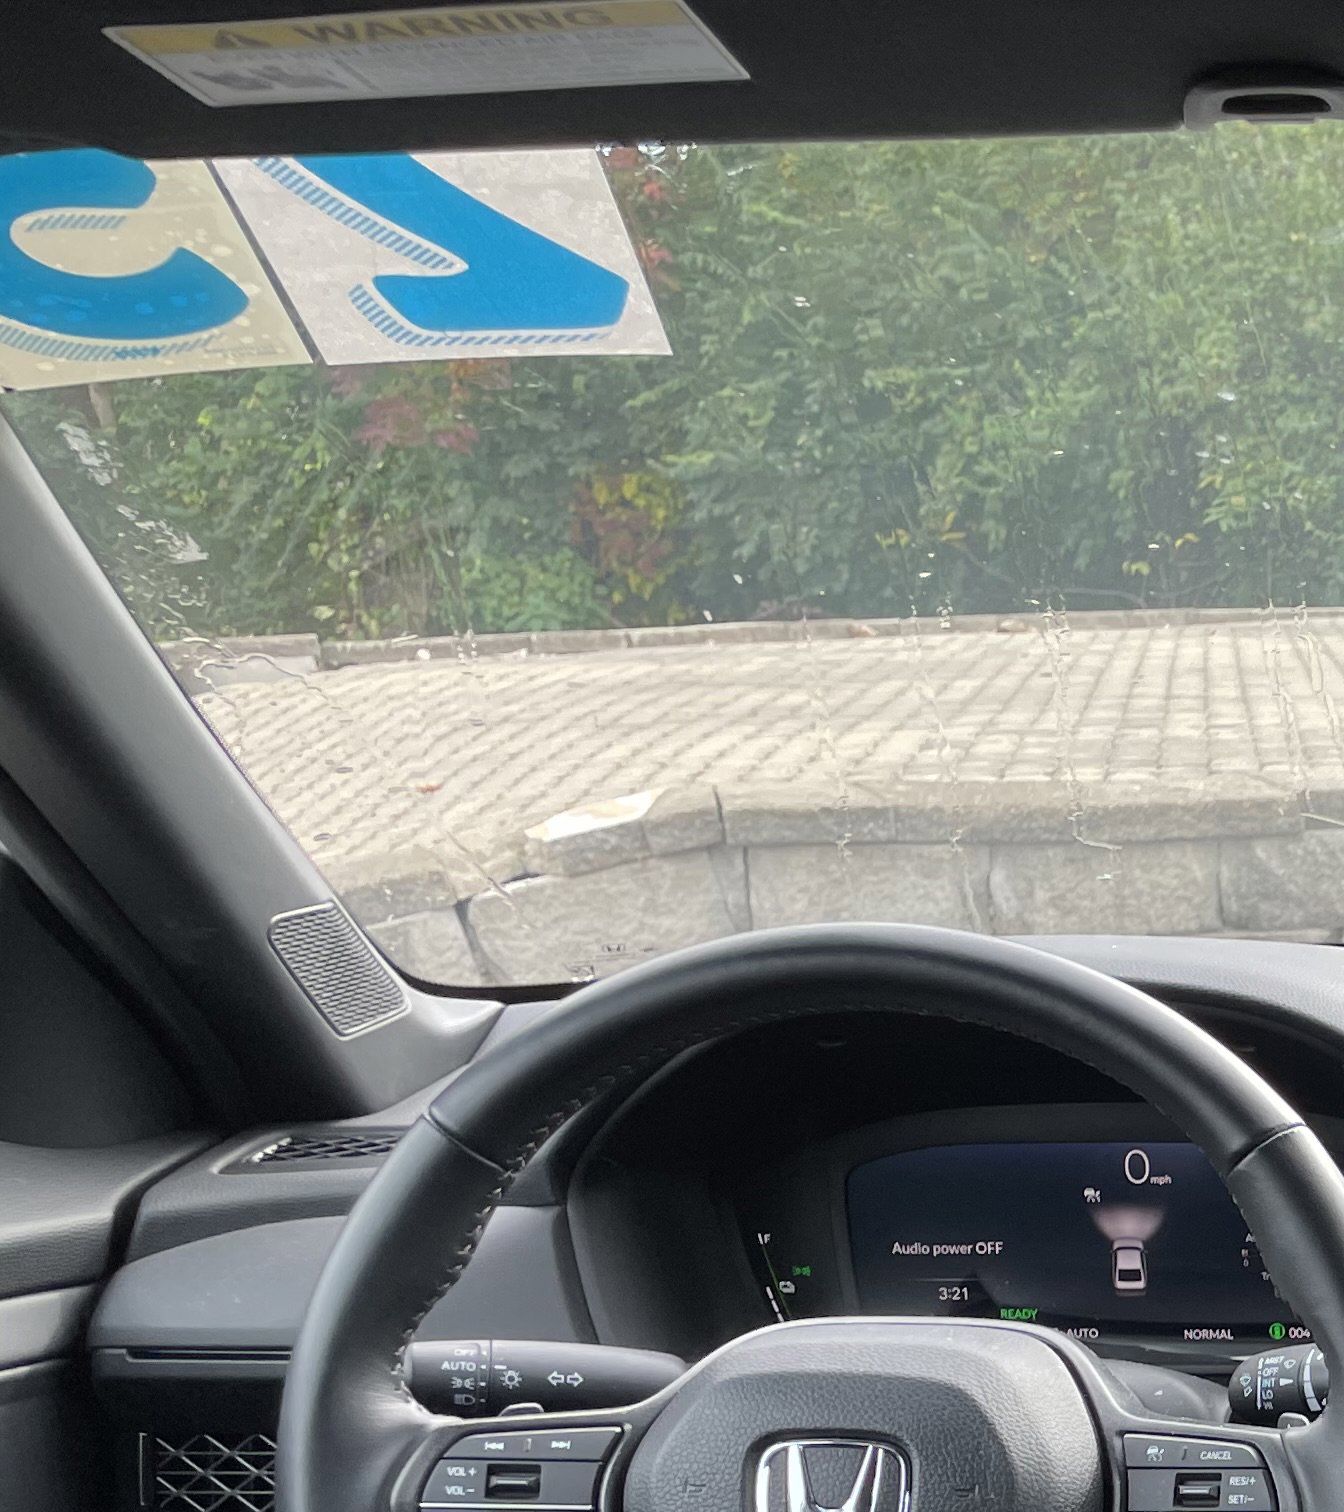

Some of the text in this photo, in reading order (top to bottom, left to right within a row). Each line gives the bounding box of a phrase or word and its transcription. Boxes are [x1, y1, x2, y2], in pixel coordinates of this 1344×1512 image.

[291, 7, 616, 44] WARNING
[1124, 1149, 1172, 1186] 0 mph
[891, 1241, 1004, 1257] Audio power OFF
[938, 1287, 969, 1301] 3:21
[1000, 1308, 1038, 1320] READY
[1066, 1328, 1099, 1338] AUTO
[1184, 1328, 1234, 1340] NORMAL
[441, 1361, 477, 1372] AUTO
[1262, 1367, 1279, 1376] OFF
[1261, 1378, 1275, 1388] INT
[1261, 1390, 1274, 1400] LO
[1200, 1450, 1232, 1461] CANCEL
